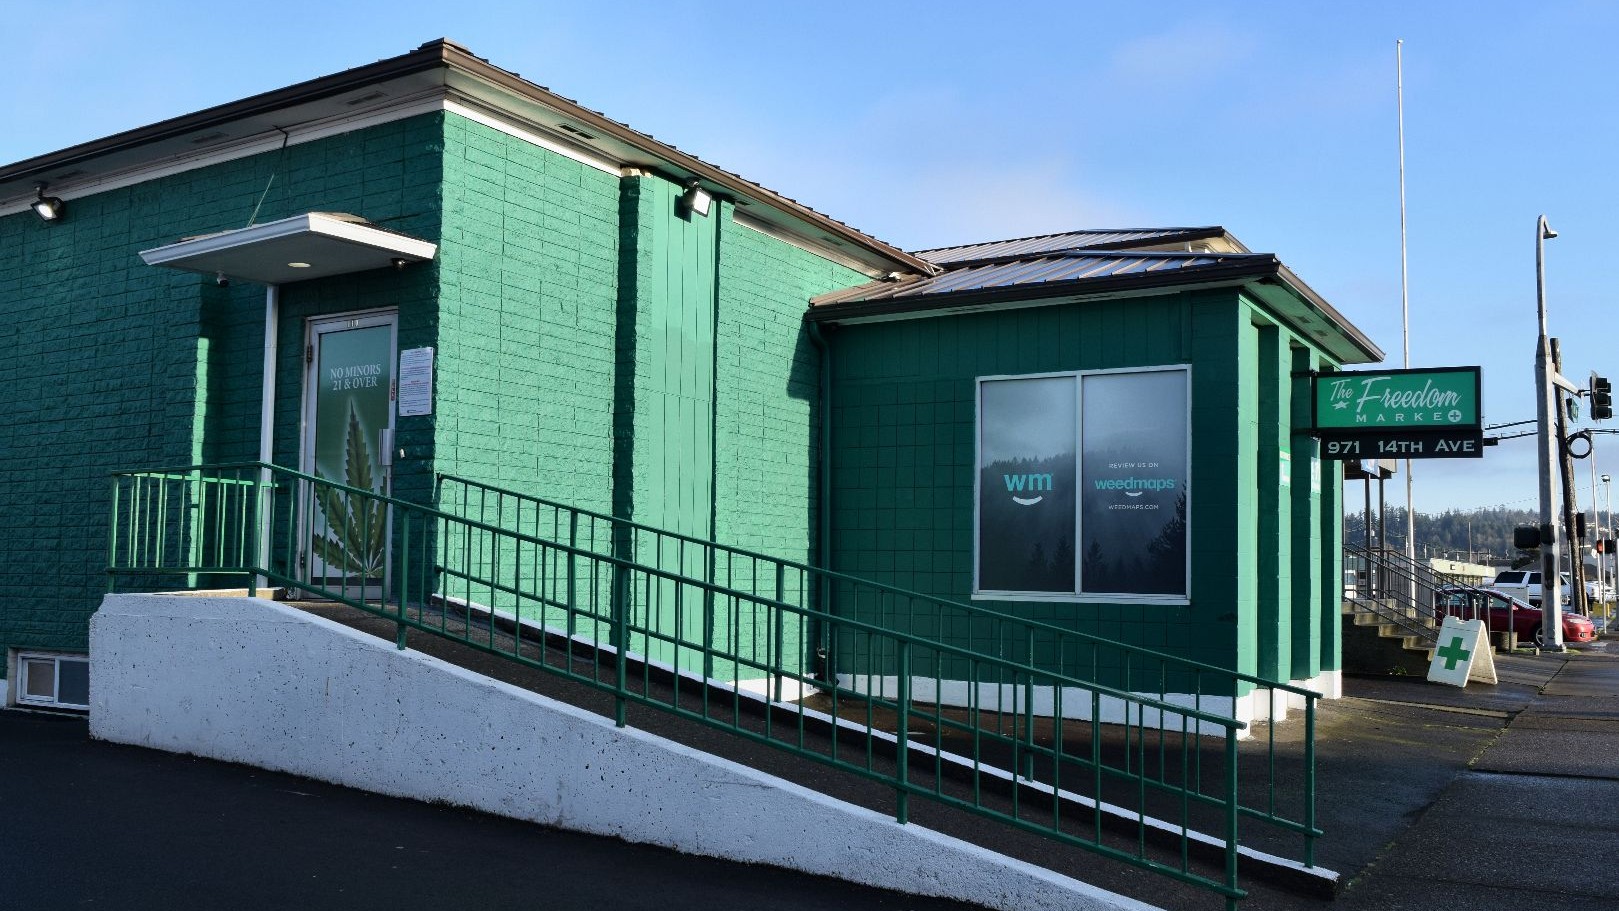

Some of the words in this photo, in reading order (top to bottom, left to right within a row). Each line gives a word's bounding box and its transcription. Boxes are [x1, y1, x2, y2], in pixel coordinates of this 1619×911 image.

[330, 367, 343, 379] NO
[345, 364, 381, 378] MINORS
[333, 380, 342, 391] 21
[344, 379, 351, 389] &
[353, 376, 378, 389] OVER
[1330, 378, 1354, 401] The
[1356, 376, 1462, 412] Freedom
[1327, 440, 1360, 454] 971
[1377, 440, 1423, 453] 14TH
[1434, 439, 1475, 452] AVE
[1004, 473, 1052, 491] wm
[1094, 476, 1175, 491] weedmaps
